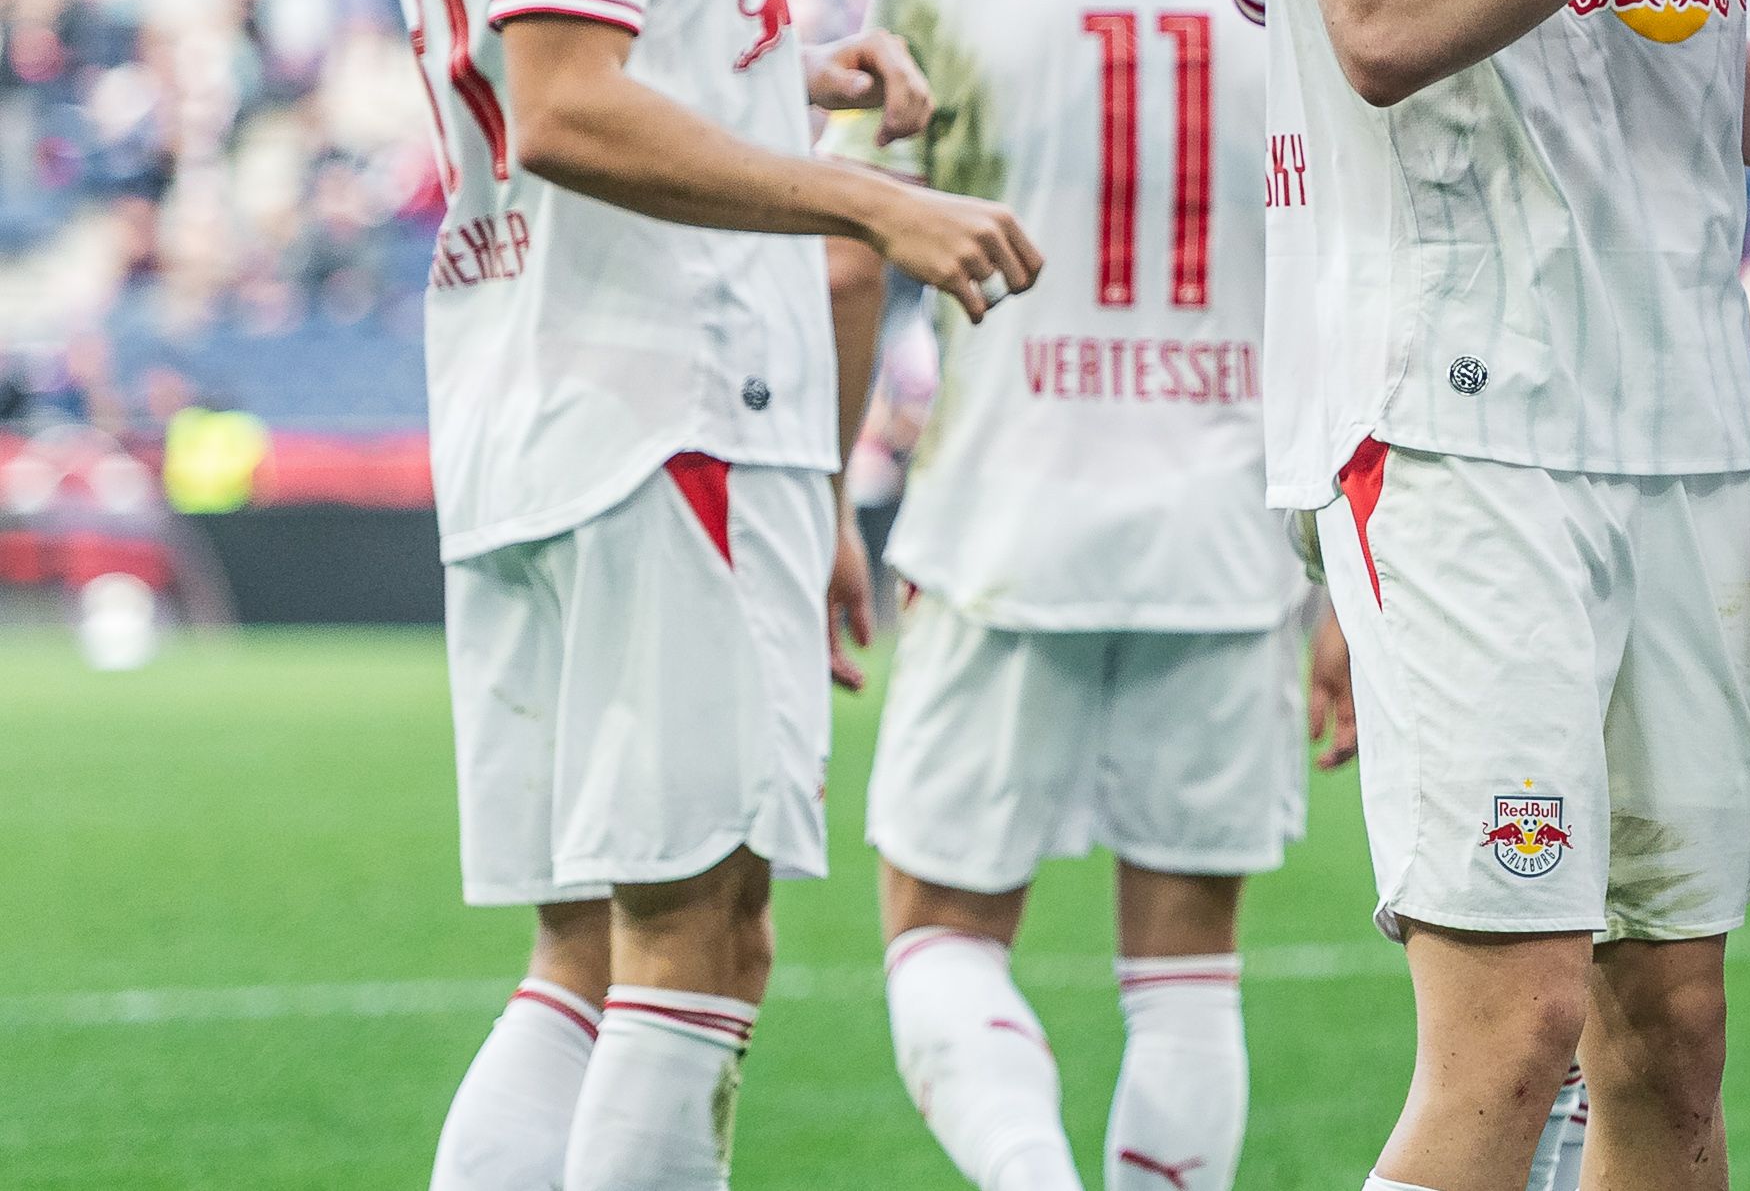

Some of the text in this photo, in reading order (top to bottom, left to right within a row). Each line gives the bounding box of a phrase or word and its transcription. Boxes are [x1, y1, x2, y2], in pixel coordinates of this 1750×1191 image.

[1083, 13, 1209, 304] 11
[1023, 337, 1263, 404] VERTESSEN
[1502, 847, 1556, 873] SALZBURG
